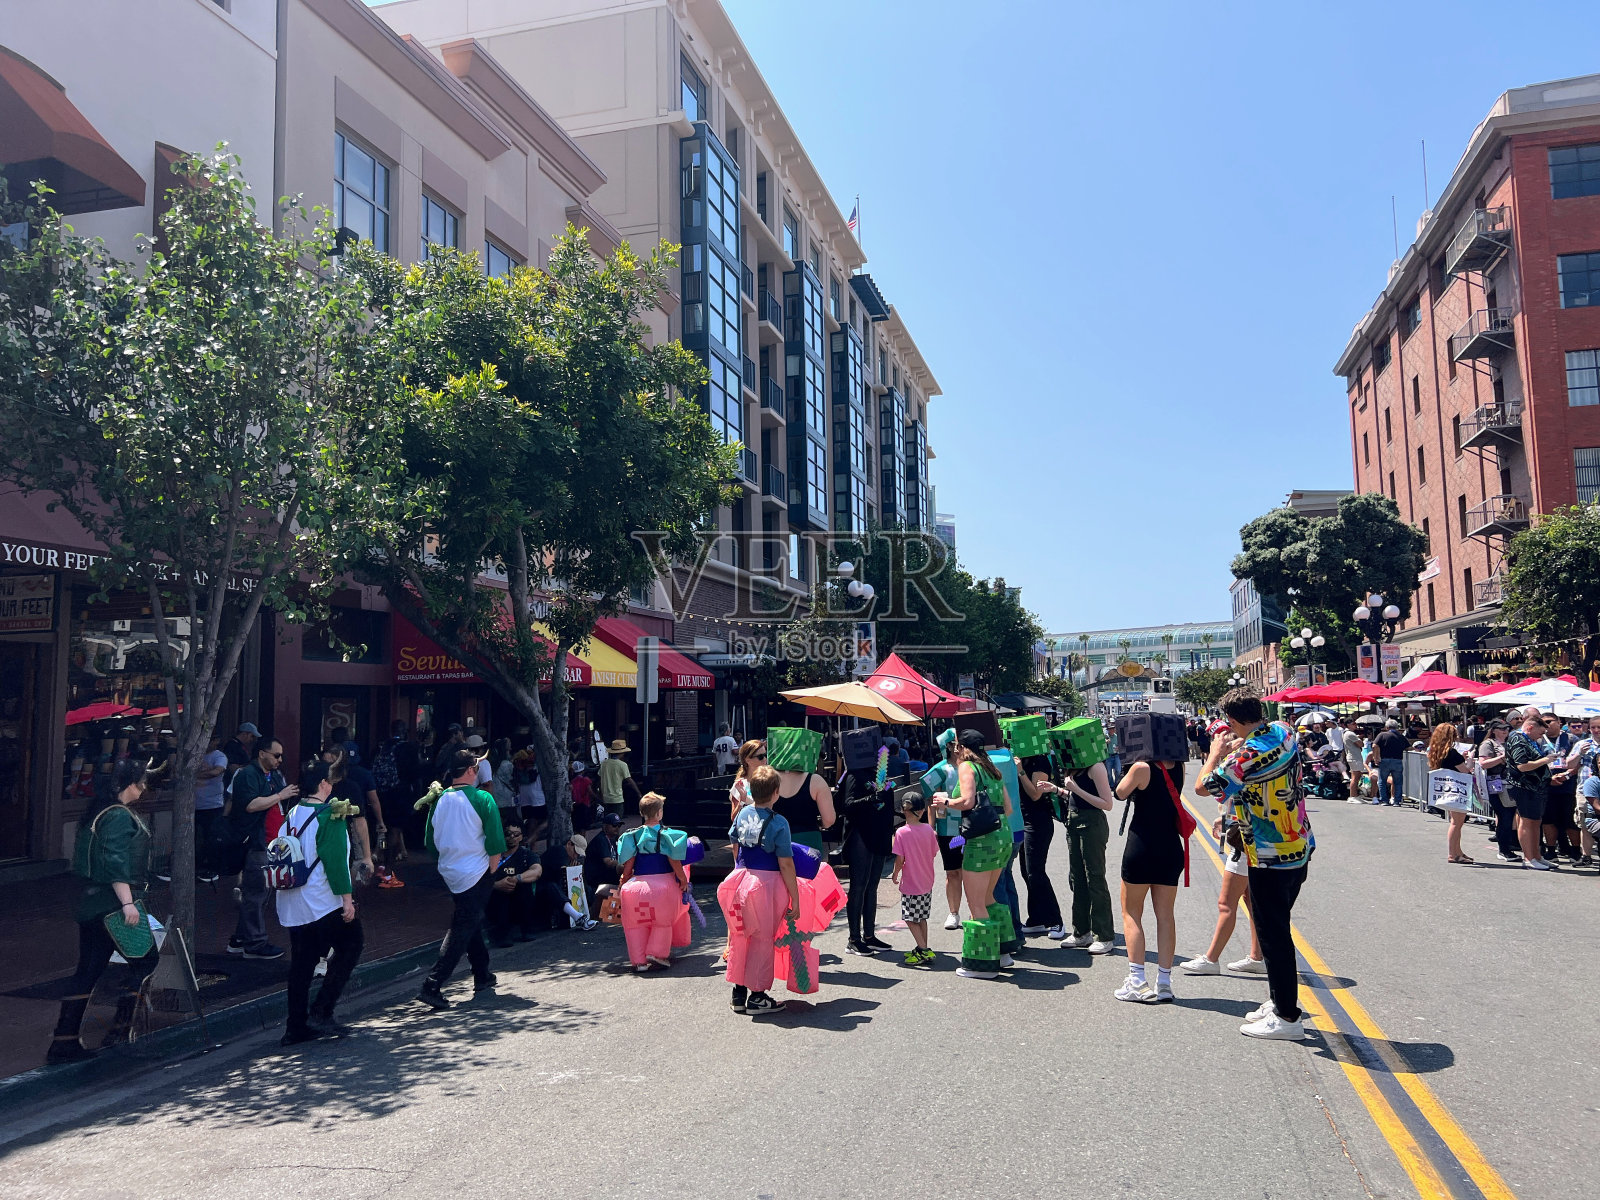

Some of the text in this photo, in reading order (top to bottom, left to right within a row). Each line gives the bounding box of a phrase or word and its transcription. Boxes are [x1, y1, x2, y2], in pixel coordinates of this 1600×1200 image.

[2, 542, 60, 568] YOUR
[398, 647, 467, 672] Sevi
[397, 673, 436, 681] RESTAURANT
[442, 672, 461, 680] TAPAS
[461, 671, 475, 679] BAR
[563, 667, 583, 683] BAR
[592, 671, 616, 686] ANISH
[677, 674, 711, 689] LIVE MUSIC
